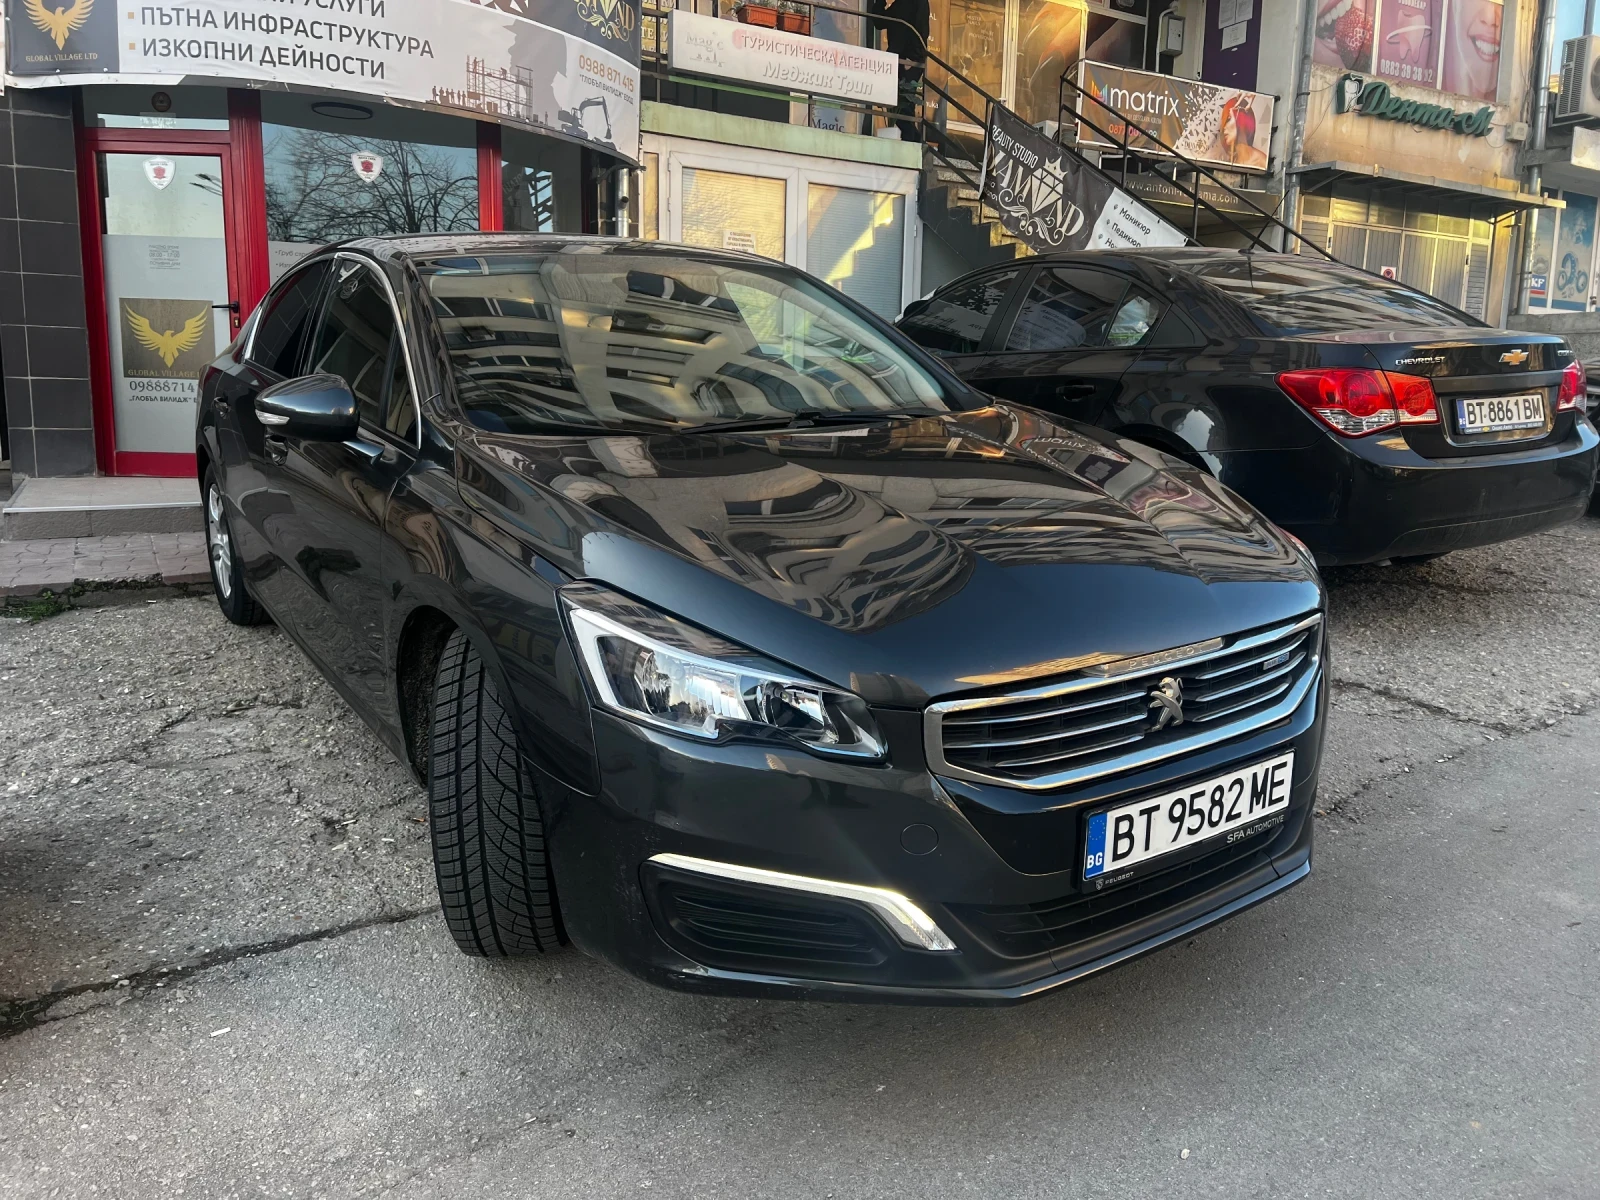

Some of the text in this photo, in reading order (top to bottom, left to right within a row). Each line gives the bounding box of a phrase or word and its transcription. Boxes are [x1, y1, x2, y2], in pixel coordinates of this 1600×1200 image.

[141, 7, 434, 59] ПЪТНА ИНФРАСТРУКТУРА
[25, 52, 98, 63] GLOBAL VILLAGE LTD
[143, 38, 385, 80] ИЗКОПНИ ДЕЙНОСТИ
[741, 34, 892, 75] ТУРИСТИЧЕСКА АГЕНЦИЯ
[578, 54, 635, 93] 0988 871 415
[762, 61, 874, 97] Меджик Трип
[1110, 86, 1180, 118] matrix
[812, 116, 845, 132] Magic
[1012, 142, 1038, 169] STUDIO
[1119, 207, 1151, 235] Маникюр
[1530, 276, 1545, 288] KF
[128, 369, 160, 377] GLOBAL
[161, 370, 196, 378] VILLAGE
[1395, 356, 1446, 366] CHEVROLET
[129, 380, 199, 393] 09888714
[1466, 397, 1542, 425] BT 8861 BM
[1111, 761, 1288, 863] BT 9582 ME
[1226, 814, 1285, 844] SFA AUTOMOTIVE
[1086, 851, 1104, 870] BG
[1104, 871, 1135, 885] PEUGEOT
